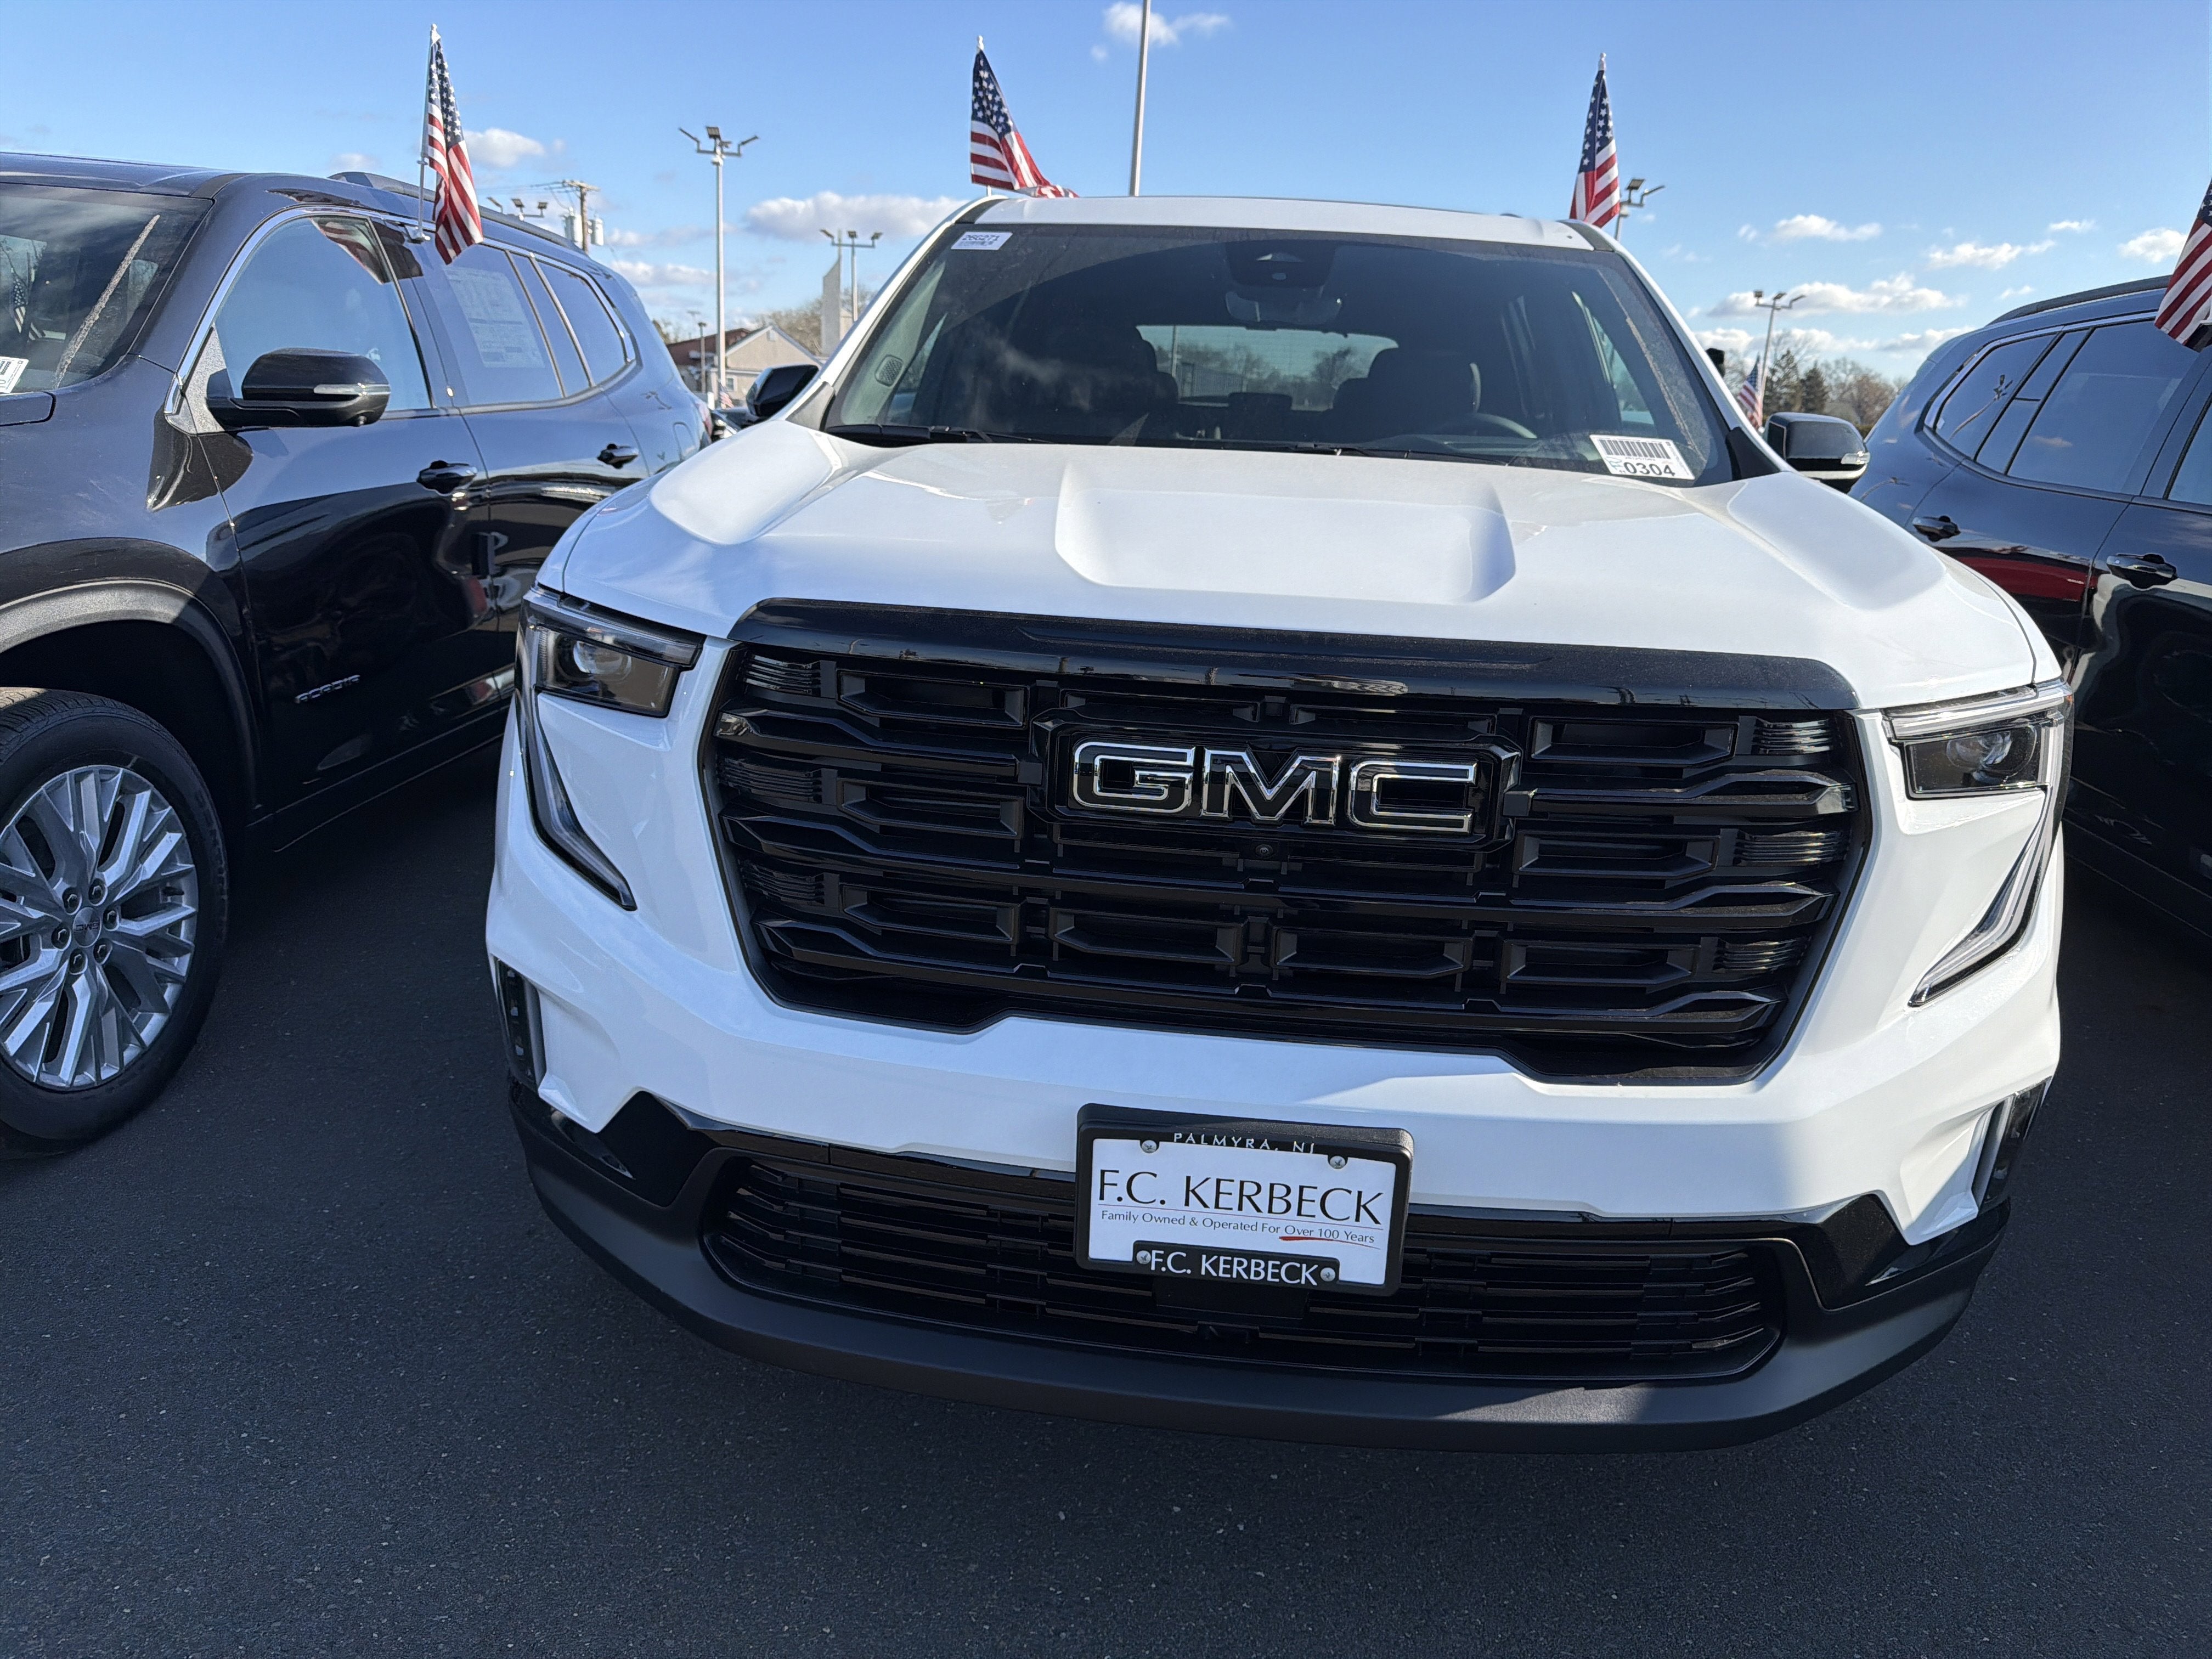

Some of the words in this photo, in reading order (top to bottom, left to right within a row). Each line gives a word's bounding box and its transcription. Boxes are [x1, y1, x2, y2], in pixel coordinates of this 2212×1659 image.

[1623, 461, 1676, 477] 0304
[294, 674, 360, 704] ACADIA
[1073, 741, 1478, 835] GMC
[1173, 1133, 1279, 1152] PALMYRA,
[1293, 1141, 1315, 1154] NJ
[1099, 1169, 1166, 1205] F.C.
[1184, 1176, 1384, 1225] KERBECK
[1102, 1210, 1139, 1224] Family
[1142, 1212, 1185, 1226] Owned
[1189, 1216, 1198, 1227] &
[1202, 1217, 1258, 1232] Operated
[1262, 1223, 1280, 1233] For
[1284, 1225, 1314, 1237] Over
[1318, 1228, 1339, 1239] 100
[1344, 1230, 1374, 1243] Years
[1150, 1250, 1192, 1274] F.C.
[1201, 1254, 1318, 1286] KERBECK
